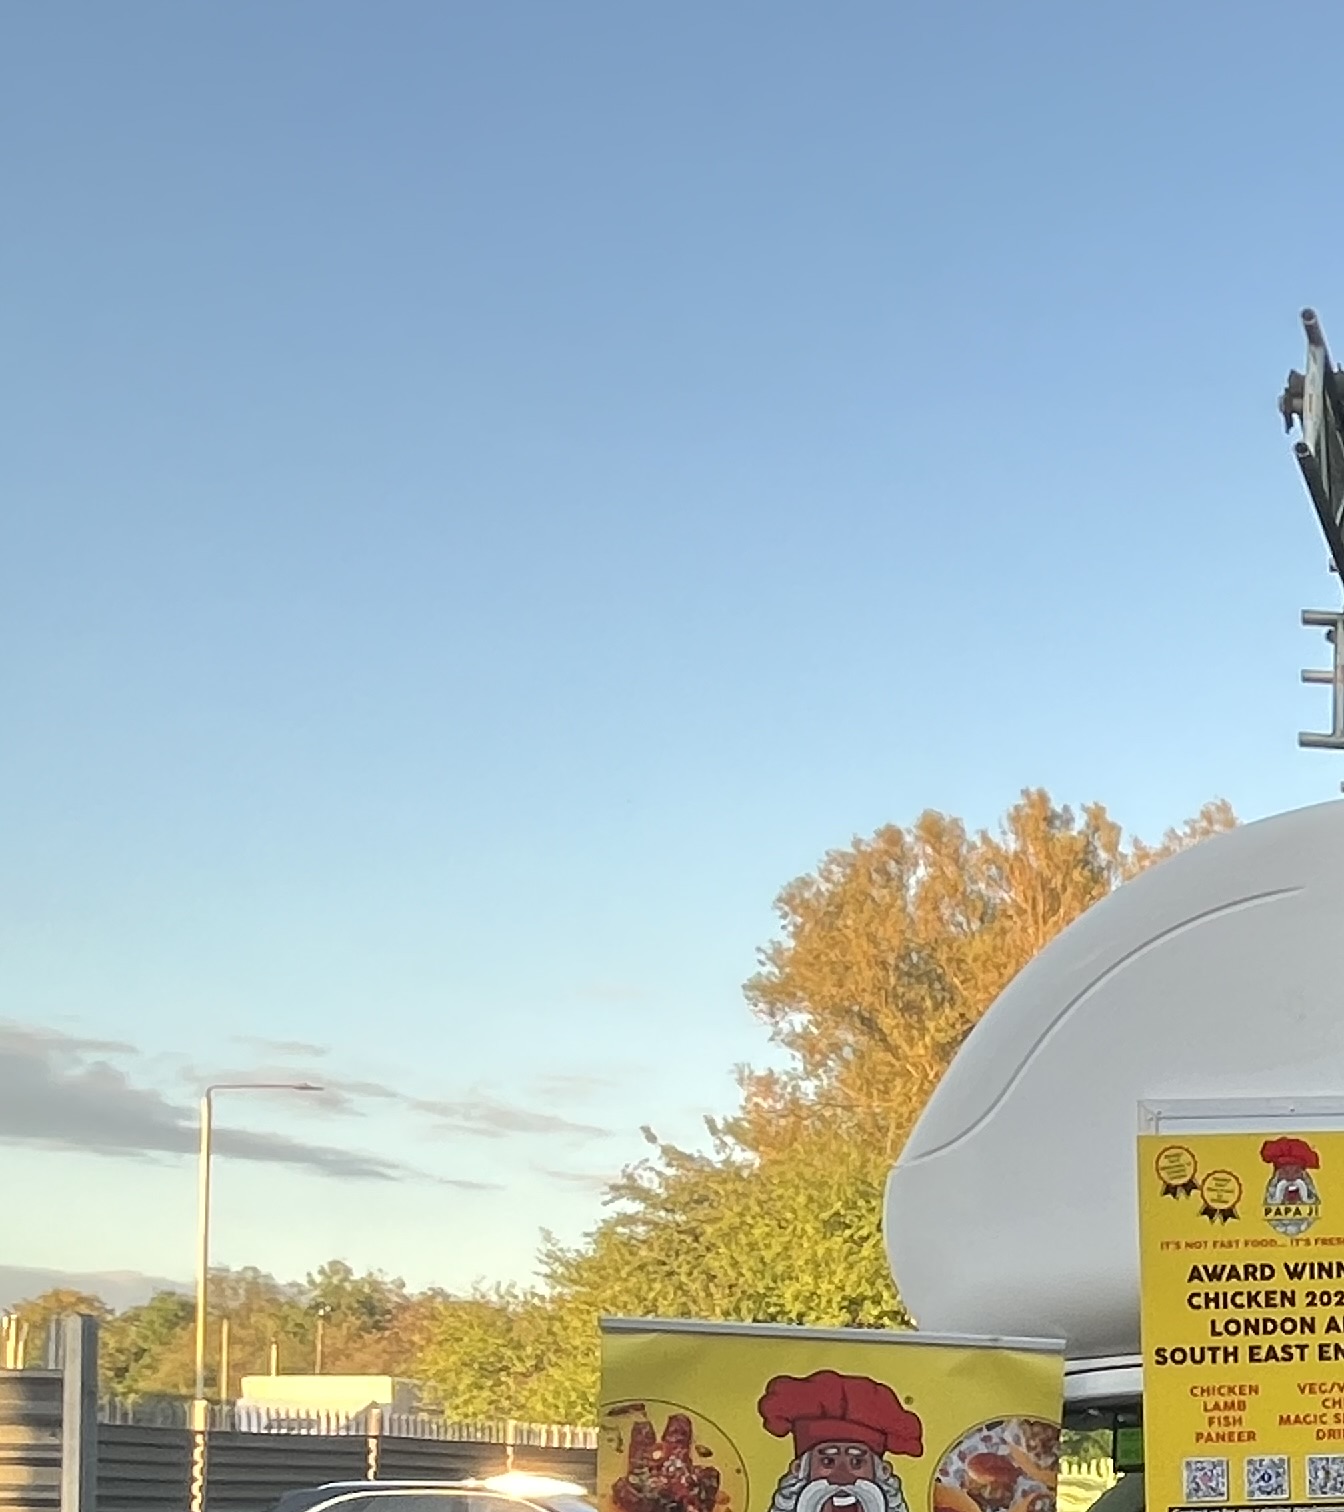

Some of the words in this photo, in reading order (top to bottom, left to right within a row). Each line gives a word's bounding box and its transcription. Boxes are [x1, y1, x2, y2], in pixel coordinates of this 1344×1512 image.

[1265, 1207, 1302, 1217] PAPA
[1307, 1207, 1319, 1217] JI
[1185, 1241, 1208, 1249] NOT
[1213, 1239, 1240, 1248] FAST
[1187, 1263, 1275, 1283] AWARD
[1187, 1290, 1296, 1310] CHICKEN
[1210, 1316, 1316, 1337] LONDON
[1154, 1346, 1238, 1366] SOUTH
[1249, 1344, 1309, 1363] EAST
[1190, 1384, 1259, 1397] CHICKEN
[1203, 1400, 1246, 1412] LAMB
[1208, 1416, 1242, 1427] FISH
[1279, 1414, 1327, 1426] MAGIC
[1195, 1431, 1256, 1443] PANEER
